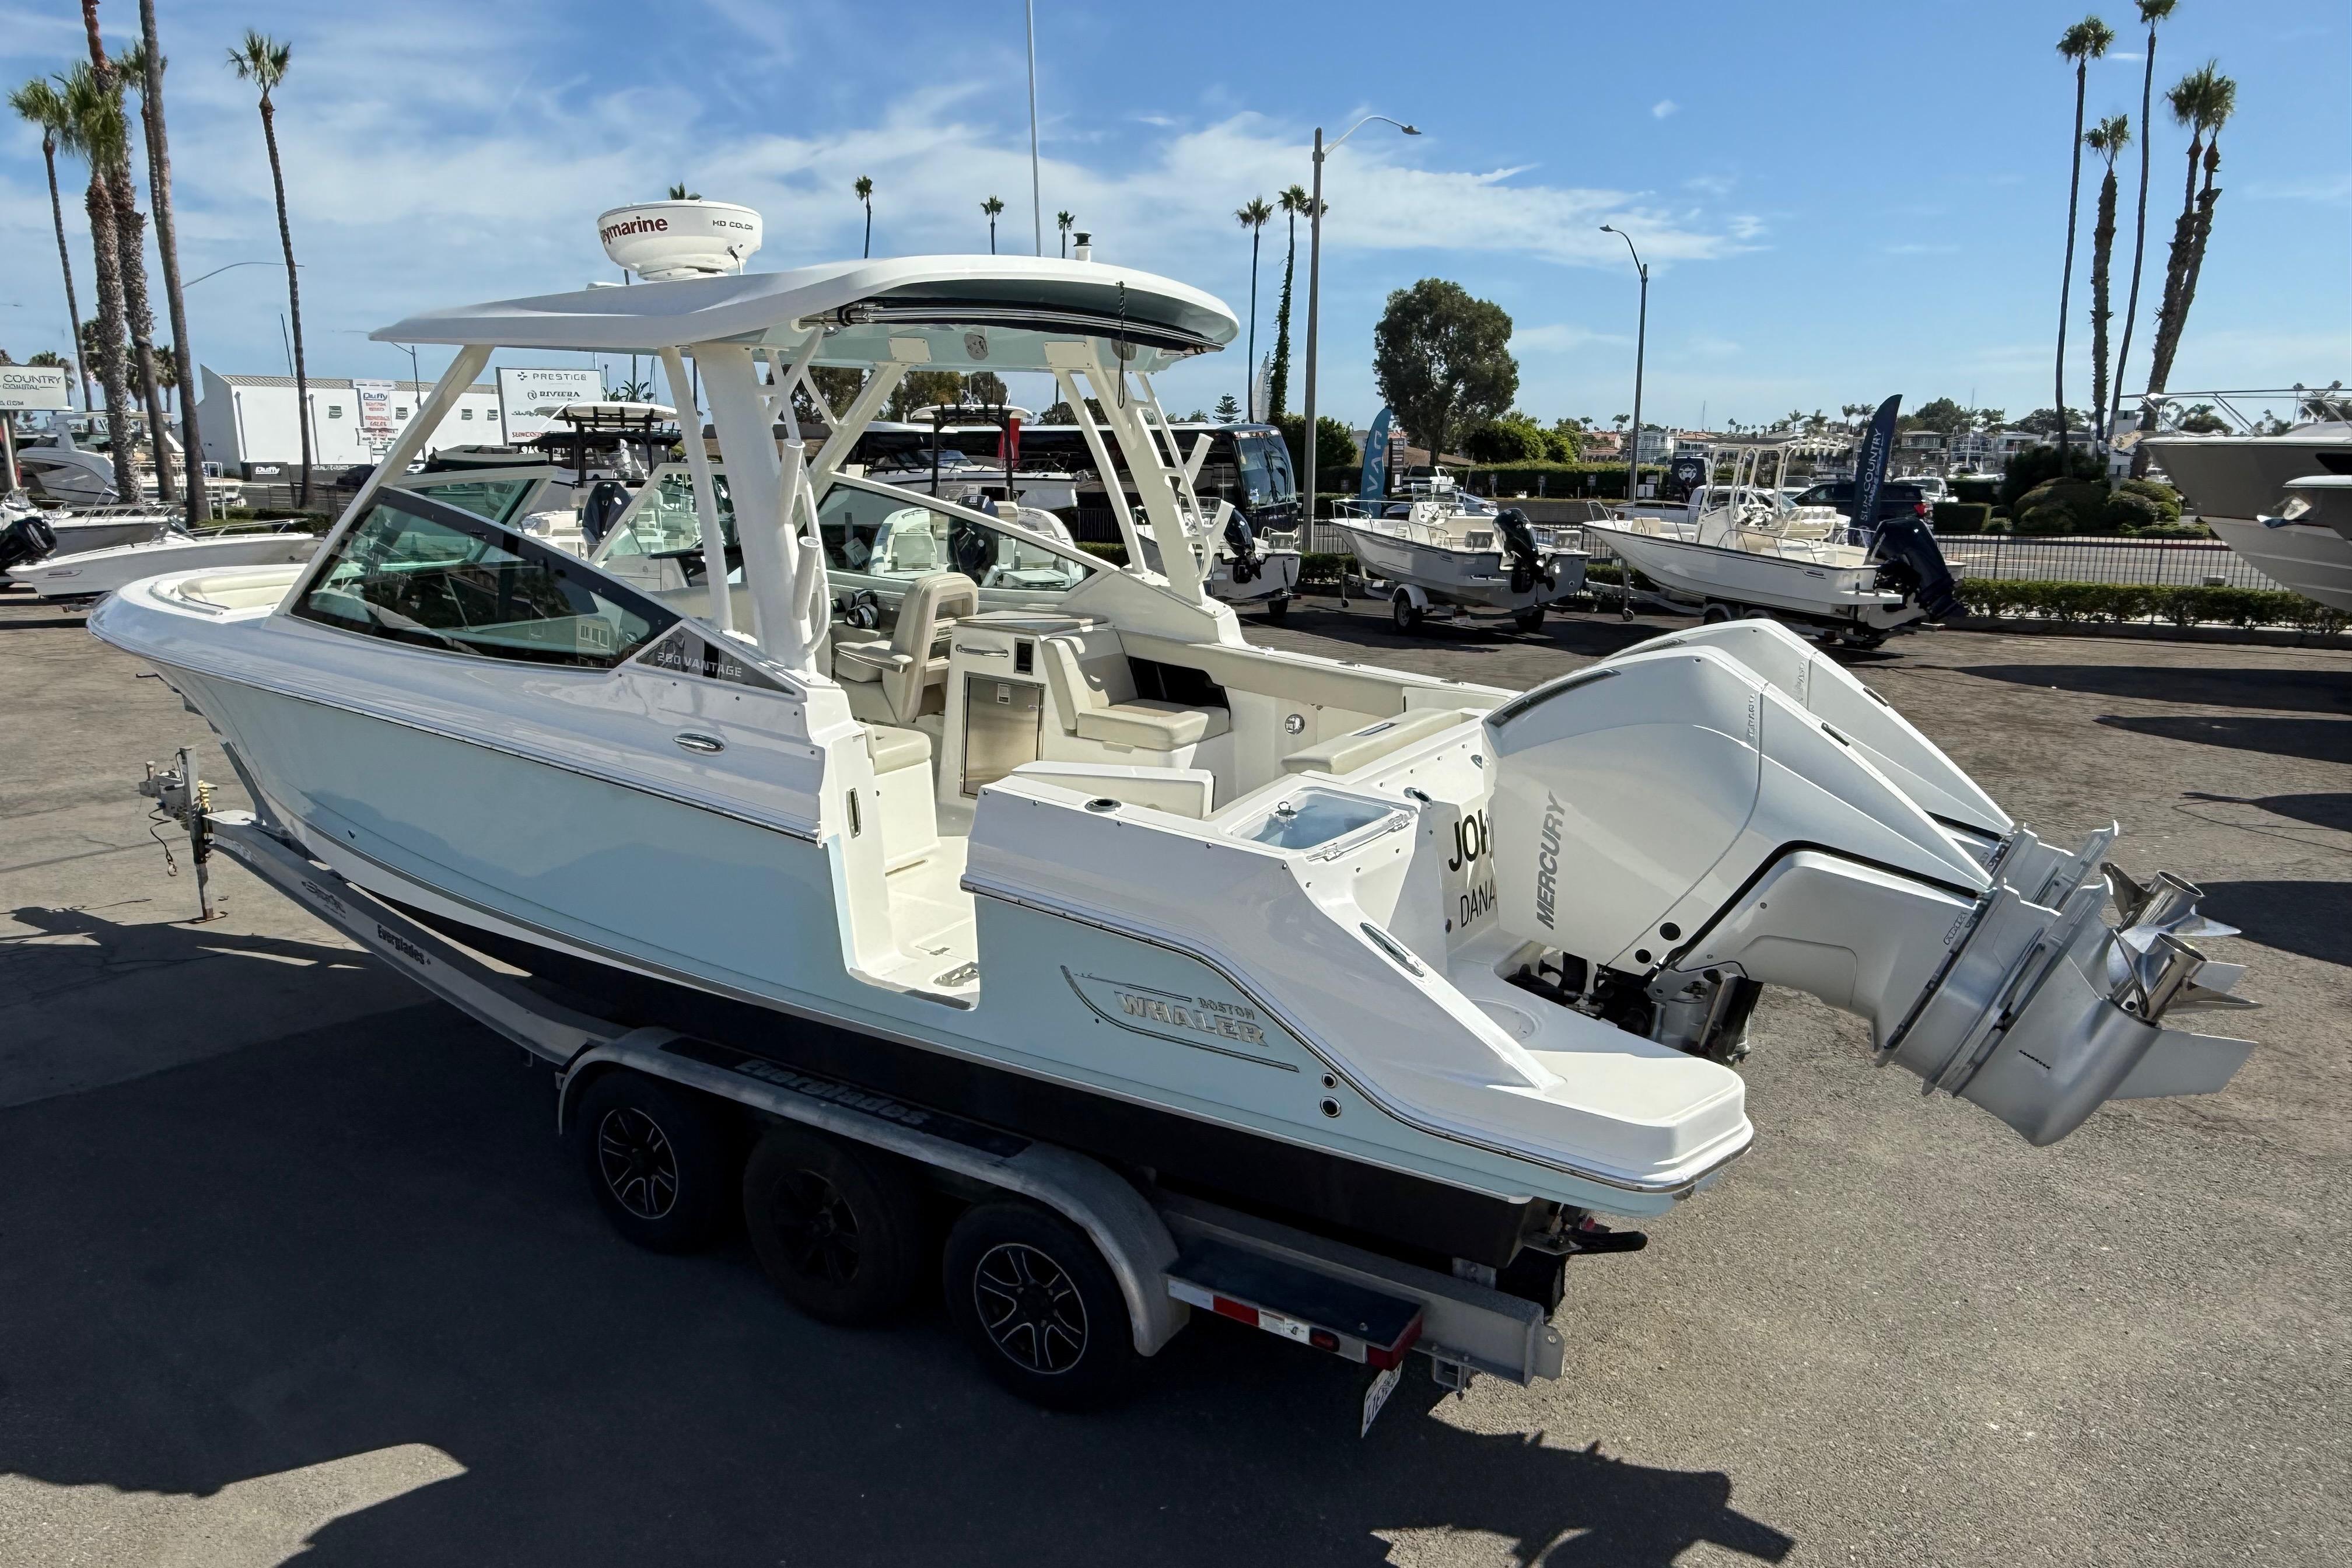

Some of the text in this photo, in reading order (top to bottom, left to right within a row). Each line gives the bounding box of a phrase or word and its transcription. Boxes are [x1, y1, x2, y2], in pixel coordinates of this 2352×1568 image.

[4, 374, 61, 384] COUNTRY
[1863, 428, 1882, 492] COUNTRY
[683, 656, 743, 678] VANTAGE
[1536, 789, 1566, 930] MERCURY
[1460, 877, 1496, 928] DANA
[1114, 991, 1269, 1047] WHALER
[1197, 997, 1255, 1020] BOSTON
